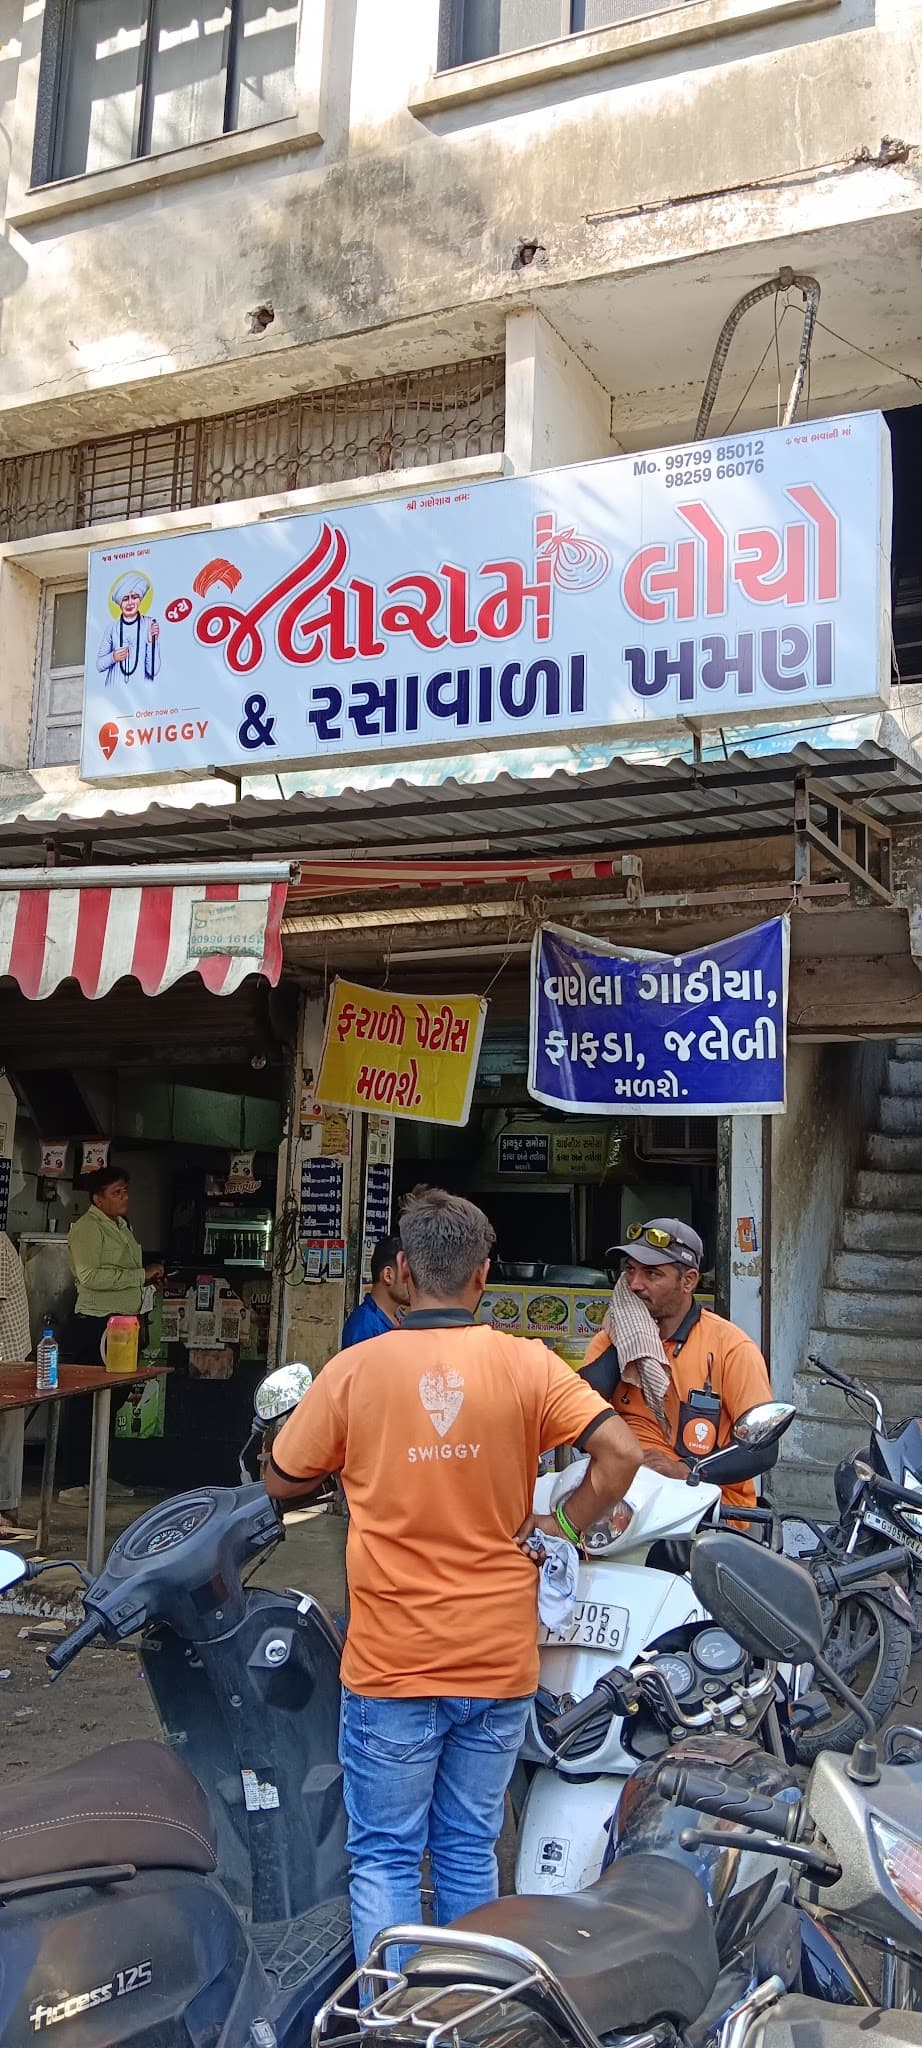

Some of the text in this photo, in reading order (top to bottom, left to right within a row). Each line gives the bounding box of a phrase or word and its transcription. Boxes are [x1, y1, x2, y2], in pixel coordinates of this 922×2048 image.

[633, 440, 764, 476] Mo. 99799 85012
[665, 458, 764, 488] 98259 66076
[406, 499, 417, 511] શ્રી
[420, 496, 451, 508] ગણેશાય
[196, 485, 837, 672] જલારામ લોચો
[167, 599, 189, 620] જય
[239, 623, 834, 749] & રસાવાળા ખમણ
[135, 710, 154, 719] Order
[170, 707, 179, 715] on
[124, 721, 208, 747] SWIGGY
[544, 957, 777, 1009] વણેલા ગાંઠીયા,
[337, 1003, 469, 1053] ફરાળી પેટીસ
[544, 1015, 777, 1071] ફાફડા, જલેબી
[357, 1059, 422, 1107] મળશે.
[614, 1070, 689, 1098] મળશે.
[408, 1443, 481, 1464] SWIGGY
[574, 1603, 611, 1624] J05
[29, 1961, 152, 2032] Access 125
